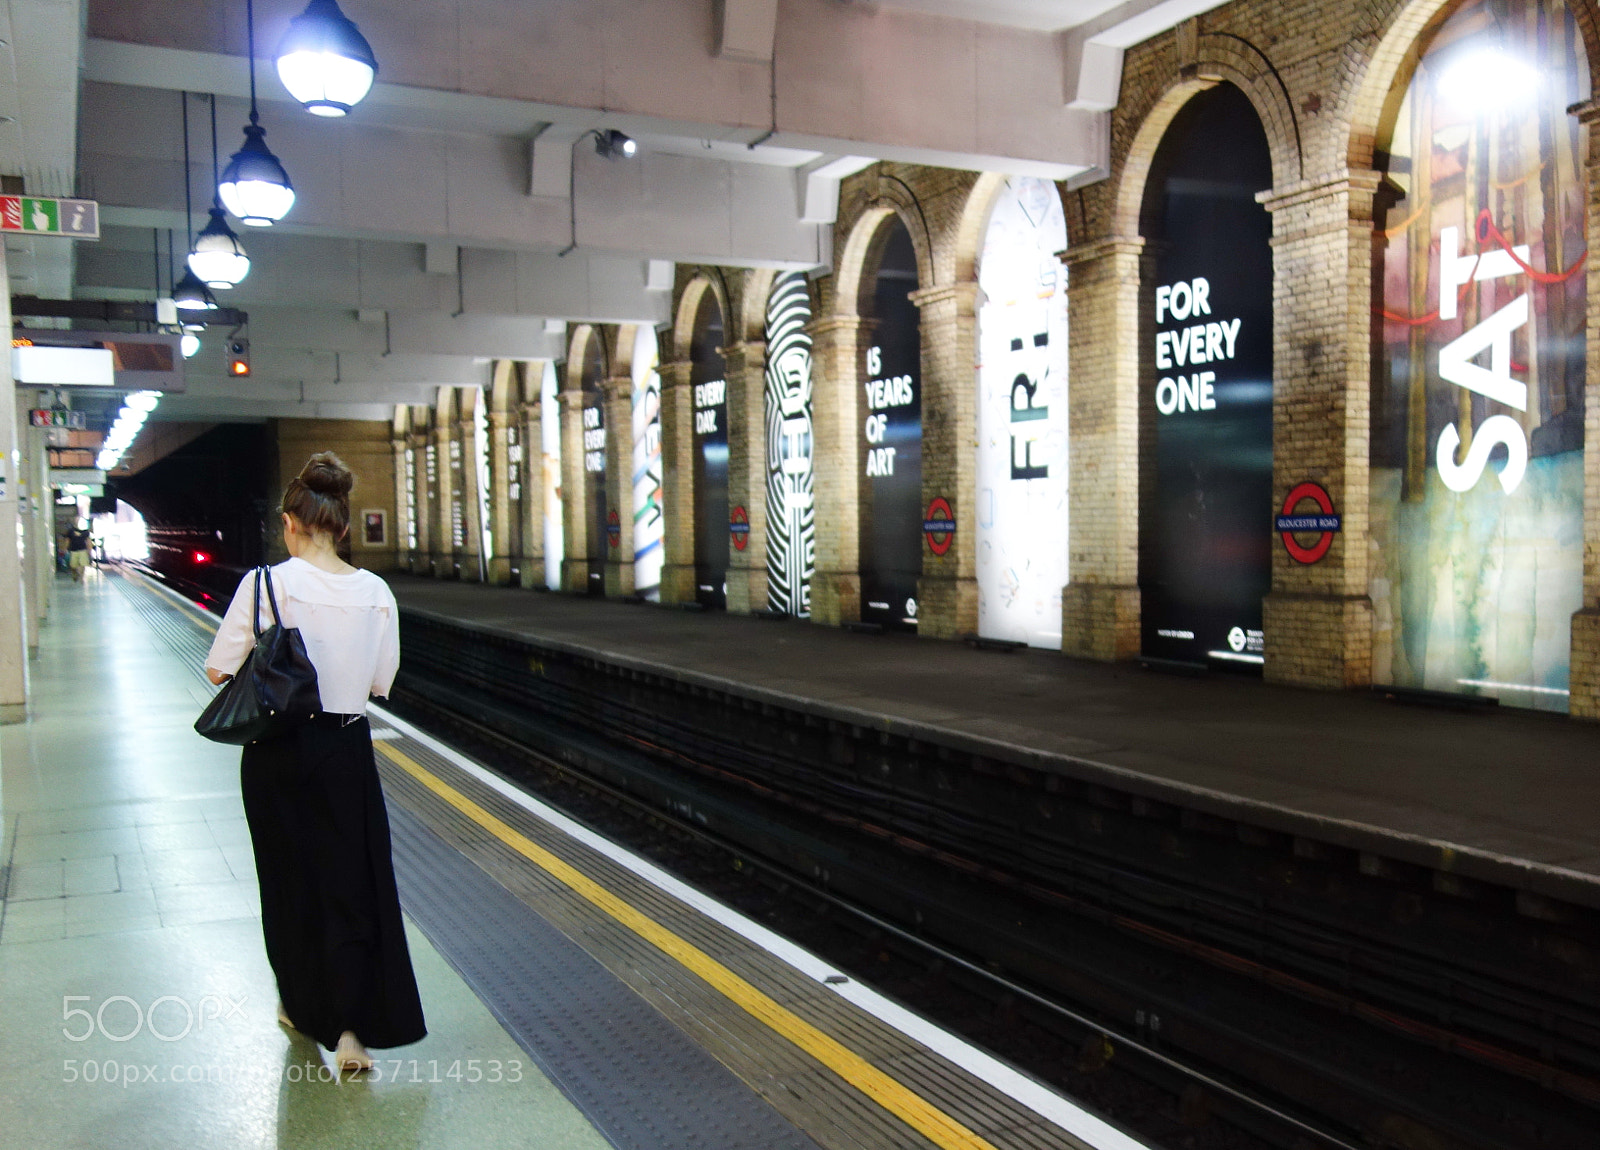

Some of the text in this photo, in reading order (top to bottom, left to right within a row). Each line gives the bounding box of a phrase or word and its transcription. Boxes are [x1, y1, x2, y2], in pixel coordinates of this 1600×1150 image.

[1156, 277, 1211, 324] FOR
[1156, 318, 1242, 370] EVERY
[1437, 226, 1530, 496] SAT
[695, 379, 726, 408] EVERY
[865, 374, 914, 410] YEARS
[1155, 371, 1217, 416] ONE
[866, 413, 888, 443] OF
[866, 447, 896, 477] ART
[1277, 517, 1338, 528] GLOUCESTER ROAD
